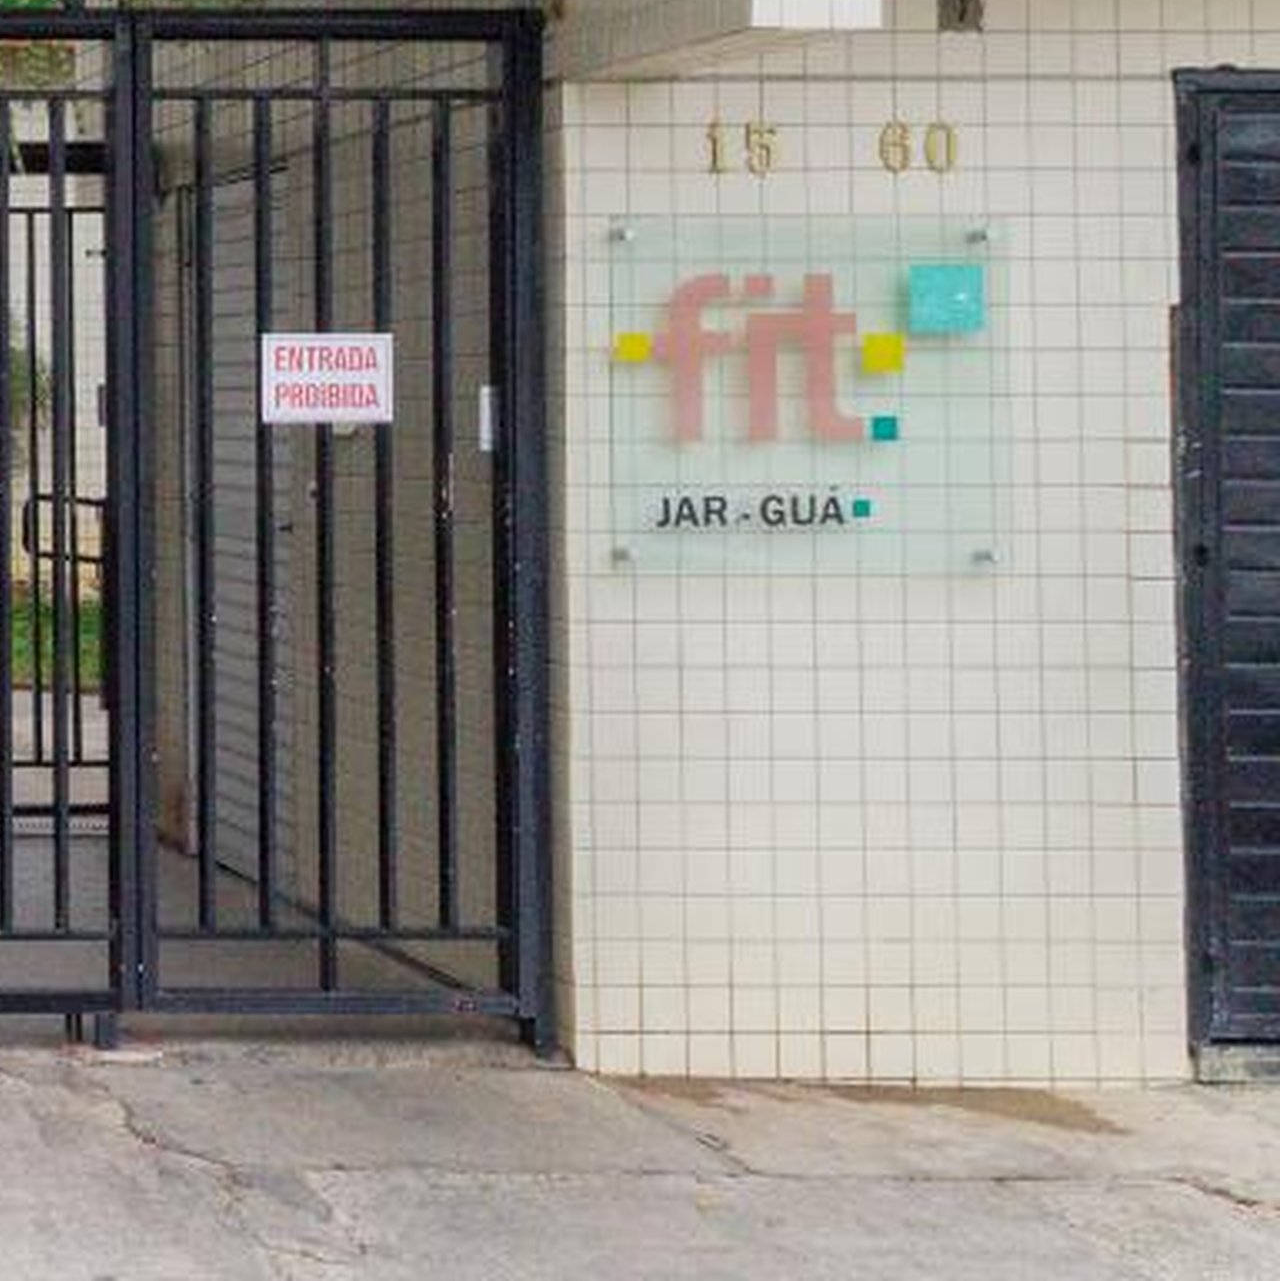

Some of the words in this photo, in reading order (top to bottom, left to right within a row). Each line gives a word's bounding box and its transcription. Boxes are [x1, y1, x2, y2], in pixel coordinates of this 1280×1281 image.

[706, 120, 778, 175] 15
[878, 120, 959, 175] 60
[274, 346, 378, 372] ENTRADA
[656, 273, 864, 443] fit
[275, 383, 380, 409] PROIBIDA
